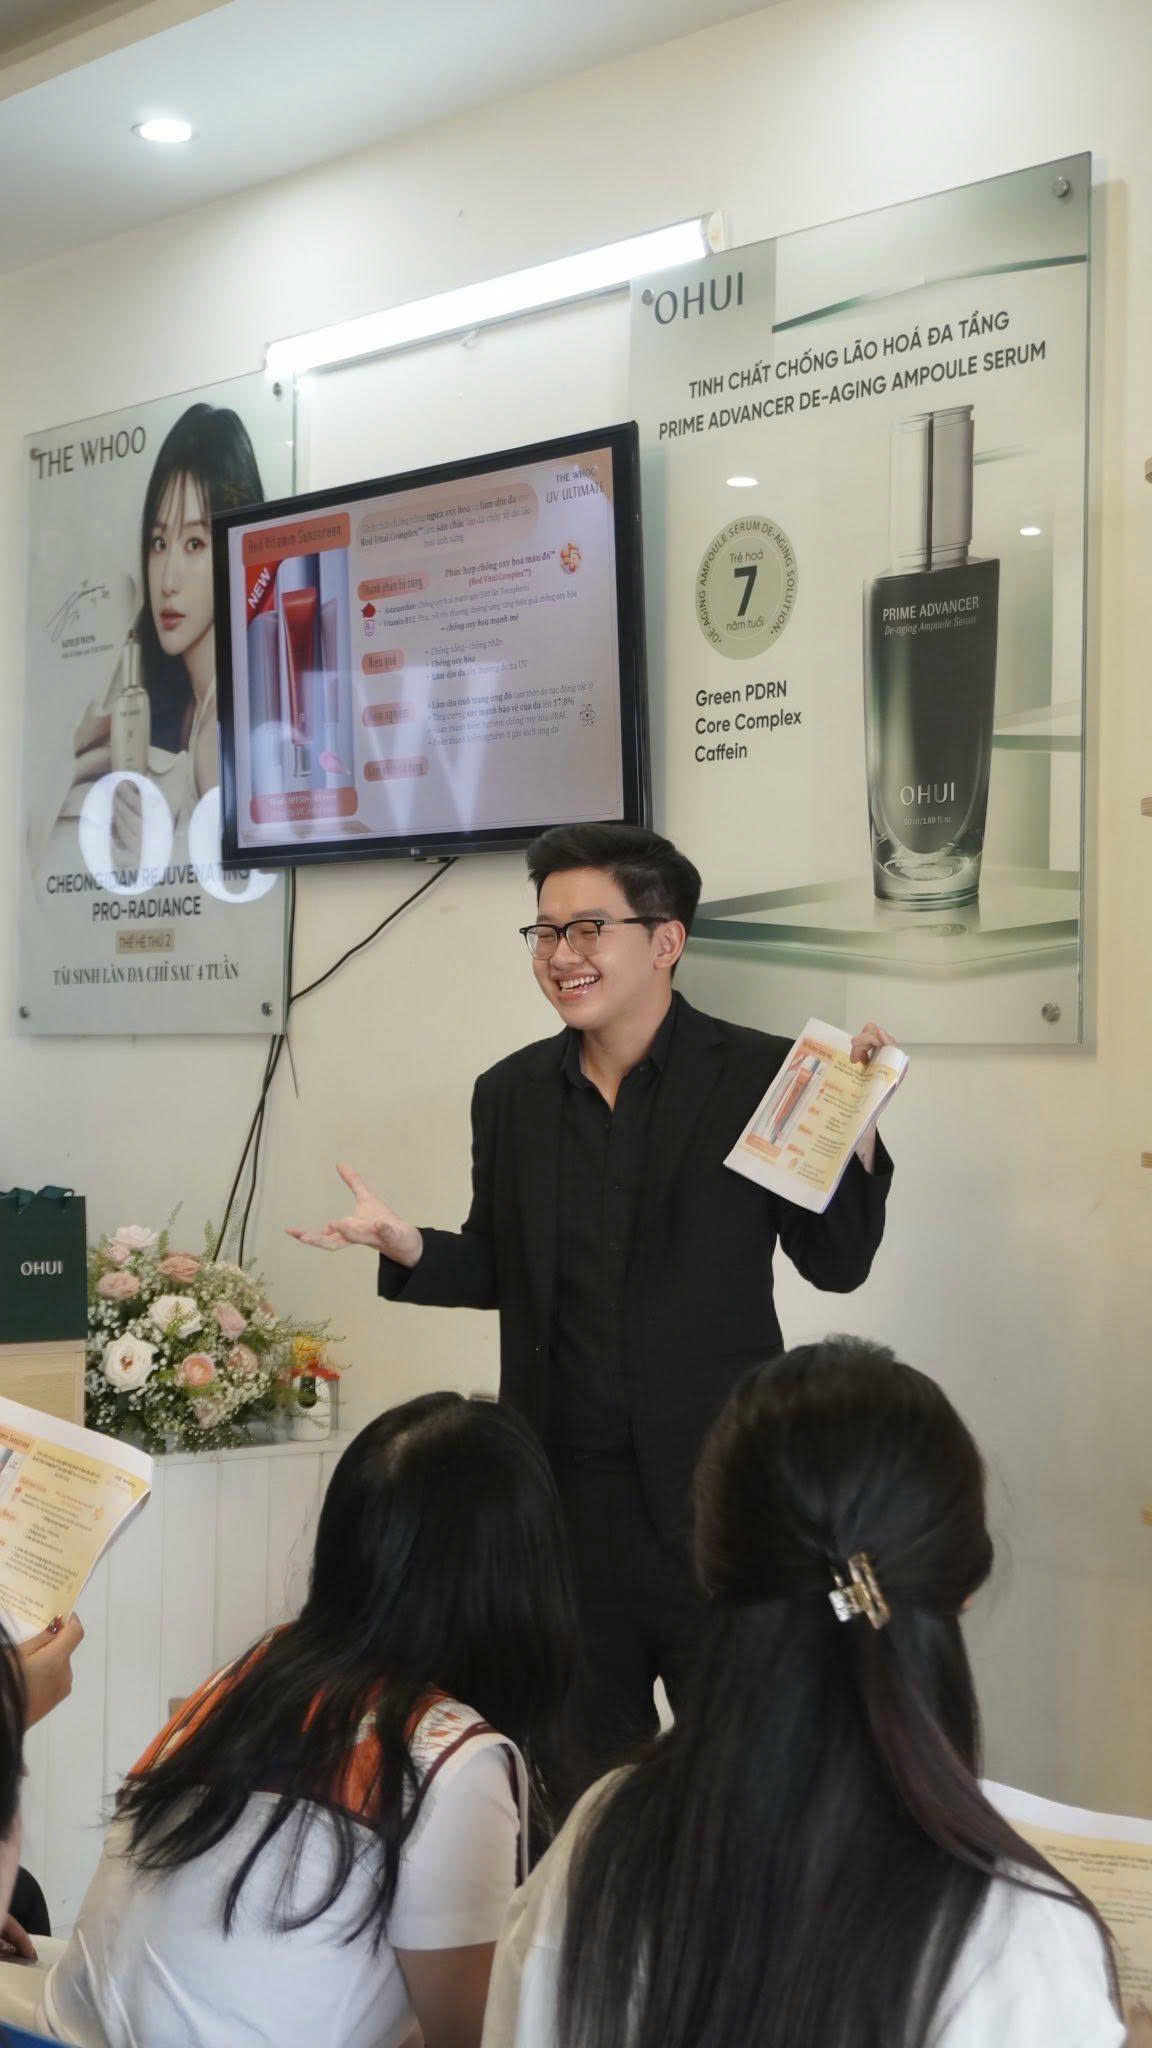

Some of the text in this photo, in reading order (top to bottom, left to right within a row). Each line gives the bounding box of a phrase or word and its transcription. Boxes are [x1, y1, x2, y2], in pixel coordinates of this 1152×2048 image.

[654, 271, 744, 326] OHUI
[688, 376, 724, 399] TINH
[728, 360, 771, 390] CHẤT
[775, 348, 839, 380] CHỐNG
[843, 339, 878, 366] LÃO
[883, 326, 922, 356] HOÁ
[927, 324, 953, 347] ĐA
[658, 340, 1046, 440] PRIME ADVANCER DE-AGING AMPOULE SERUM
[35, 426, 146, 480] THE WHOO
[247, 567, 272, 609] NEW
[698, 520, 795, 644] DE-AGING AMPOULE SERUM DE-AGING SOLUTION
[734, 565, 758, 617] 7
[882, 595, 980, 621] PRIME ADVANCER
[695, 680, 787, 707] Green PDRN
[694, 709, 802, 735] Core Complex
[694, 742, 748, 764] Caffein
[900, 781, 955, 806] OHUI
[92, 895, 201, 922] PRO-RADIANCE
[165, 933, 172, 948] 2
[53, 964, 71, 985] TÁI
[72, 967, 100, 985] SINH
[171, 964, 193, 982] SAU
[20, 1260, 63, 1277] OHUI
